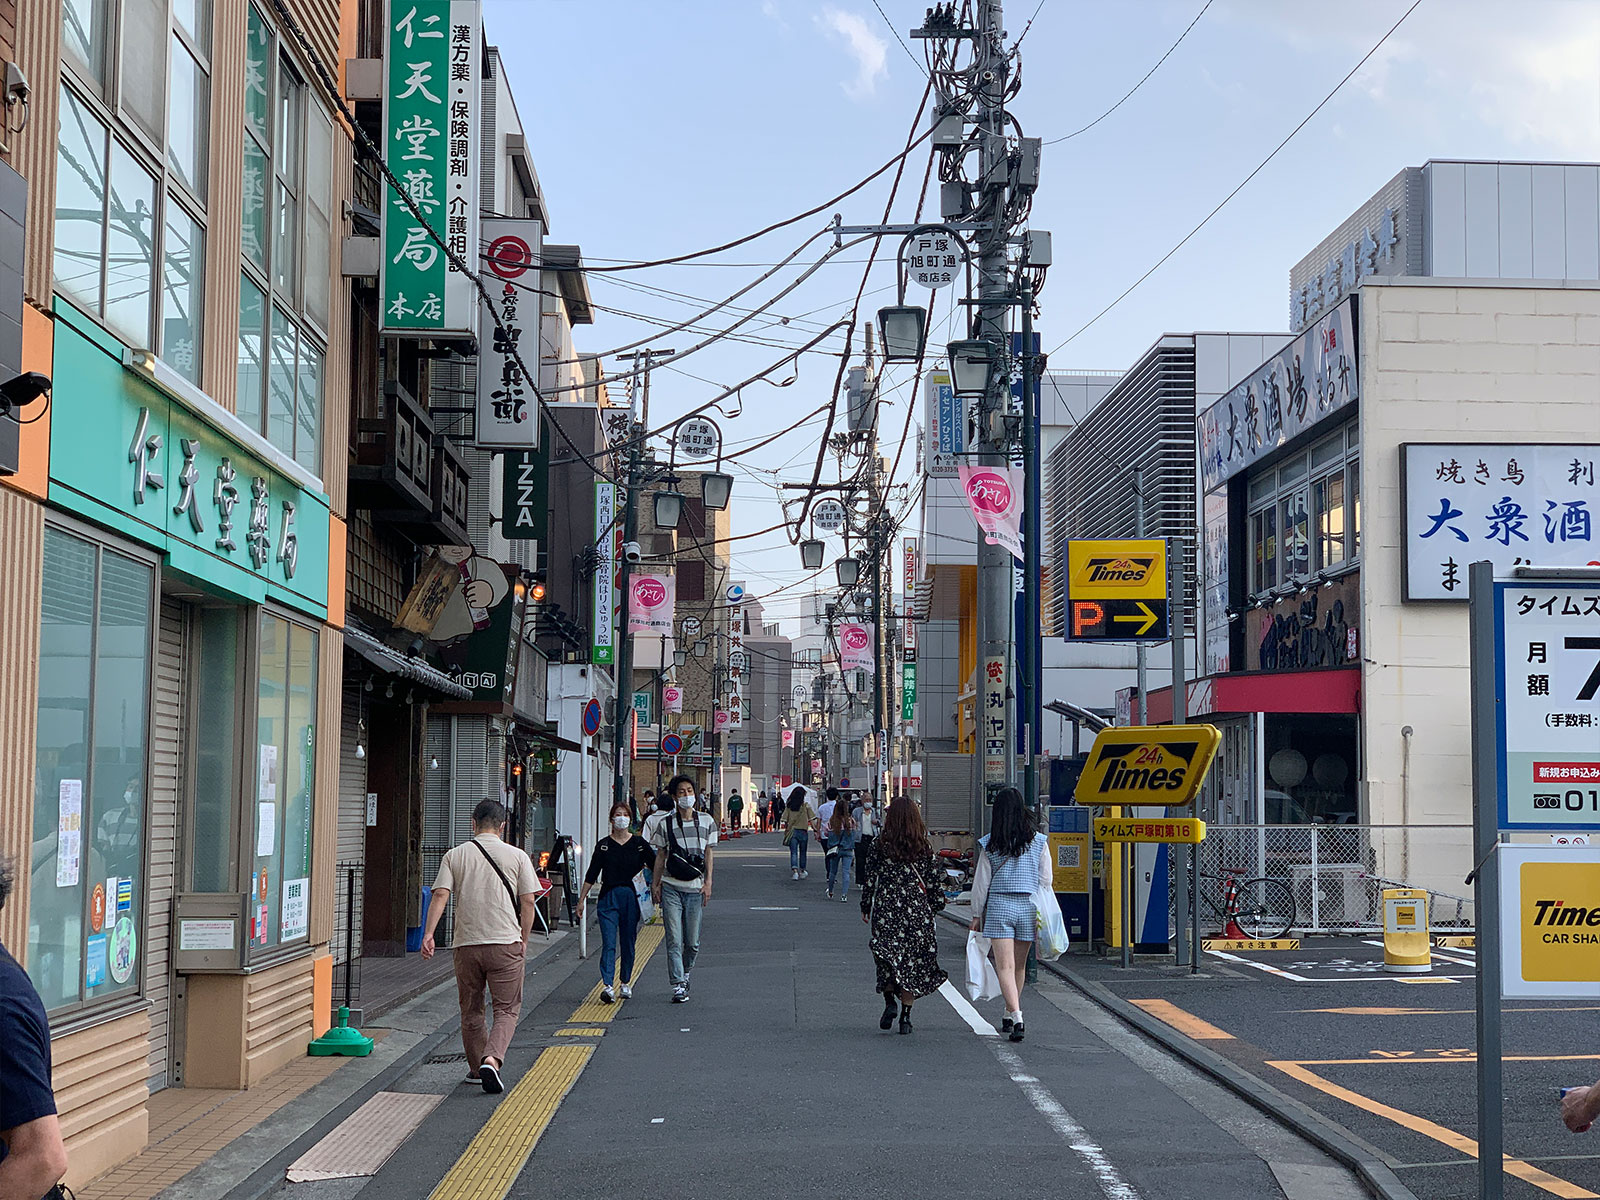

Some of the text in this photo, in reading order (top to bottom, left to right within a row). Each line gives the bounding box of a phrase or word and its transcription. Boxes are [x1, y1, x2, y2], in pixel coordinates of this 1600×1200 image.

[392, 5, 444, 272] 仁天堂薬局
[449, 25, 471, 273] 漢方薬・保険調剤・介護相談
[919, 239, 949, 252] 戸塚
[910, 255, 957, 268] 旭町通
[918, 272, 951, 283] 商店会
[388, 292, 442, 321] 本店
[1227, 355, 1308, 462] 大衆酒場
[681, 434, 713, 446] 旭町通
[687, 424, 709, 434] 戸塚
[1435, 458, 1595, 487] 焼き鳥 刺
[128, 406, 299, 579] 仁天堂薬局
[970, 480, 1009, 507] あさひ
[1418, 496, 1592, 547] 大衆酒
[906, 552, 914, 585] カラオケ
[1086, 564, 1147, 582] Times
[1112, 559, 1132, 569] 24h
[636, 583, 664, 602] あさひ
[1516, 594, 1600, 616] タイムズ
[1073, 601, 1104, 636] P
[1527, 642, 1550, 696] 月額
[904, 667, 915, 717] 業務スーパー
[1135, 746, 1163, 765] 24h
[1098, 756, 1187, 794] Times
[1539, 766, 1600, 779] 新規お申込み
[1565, 789, 1598, 811] 01
[1099, 824, 1191, 838] タイムズ戸塚町第16
[1533, 900, 1600, 927] Time
[1236, 941, 1278, 949] 高さ注意
[1542, 933, 1600, 944] CAR SHA
